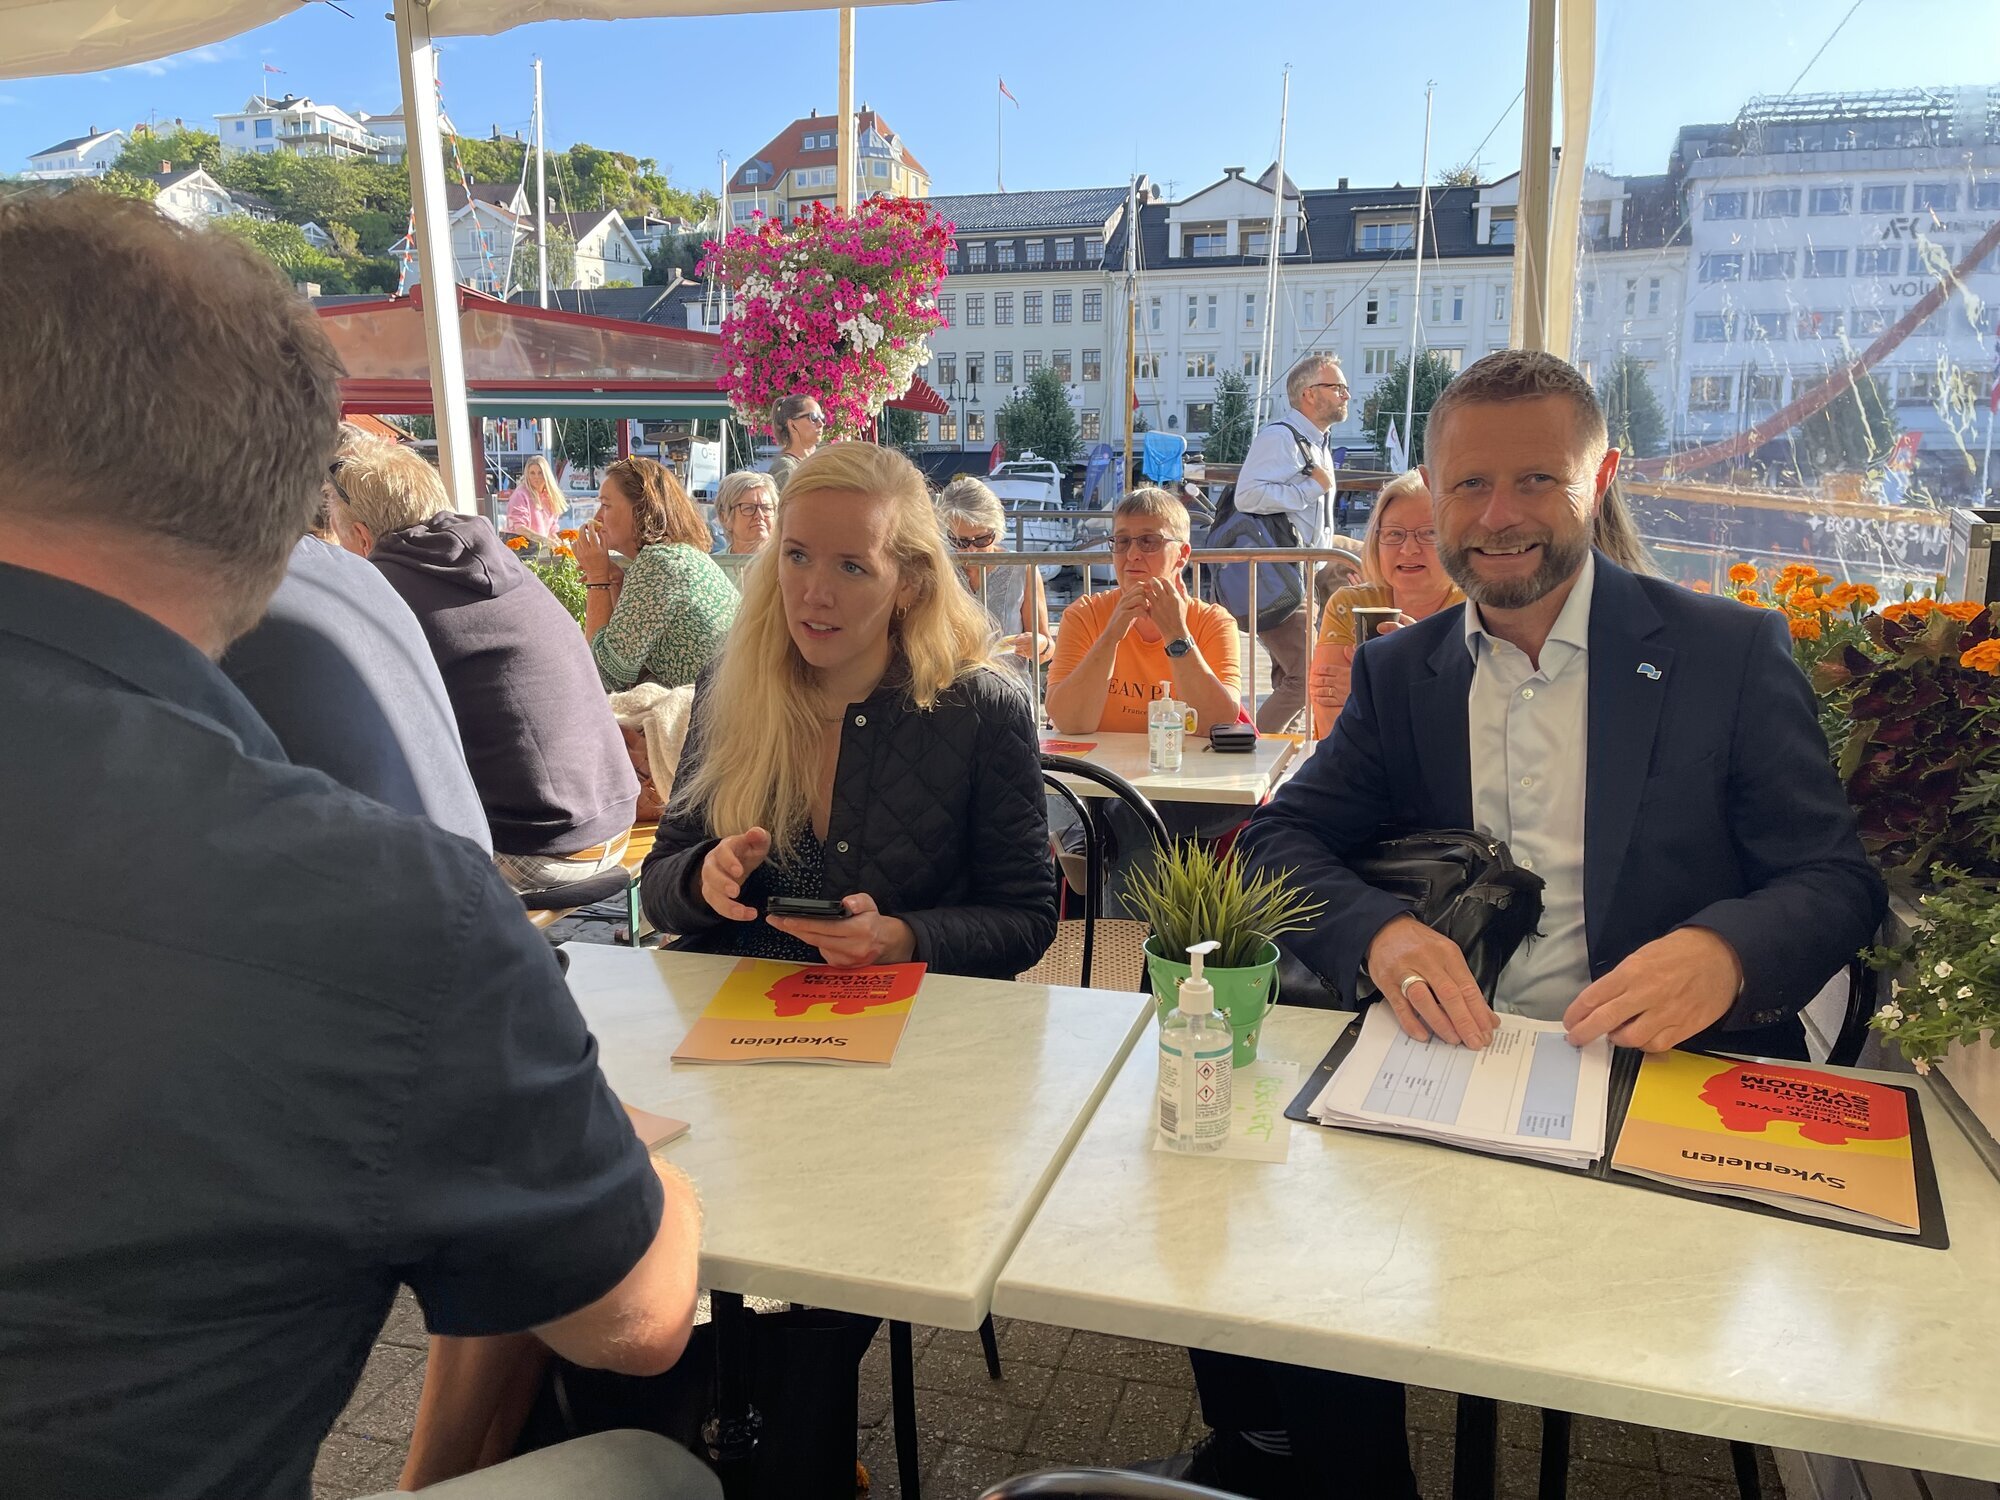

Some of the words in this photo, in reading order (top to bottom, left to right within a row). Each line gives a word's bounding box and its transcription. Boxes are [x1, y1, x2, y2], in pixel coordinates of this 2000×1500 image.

[1881, 217, 1920, 240] AFK
[1824, 515, 1872, 534] BOY
[1108, 678, 1145, 699] EAN
[730, 1036, 849, 1047] Sykepleien
[1740, 1075, 1870, 1106] SYKDOM
[1740, 1083, 1870, 1112] SOMATISK
[1735, 1101, 1784, 1114] SYKE
[1796, 1099, 1841, 1111] ANDRE
[1802, 1104, 1870, 1121] TIDLIGERE
[1787, 1110, 1870, 1131] PSYKISK
[1680, 1150, 1846, 1190] Sykepleien
